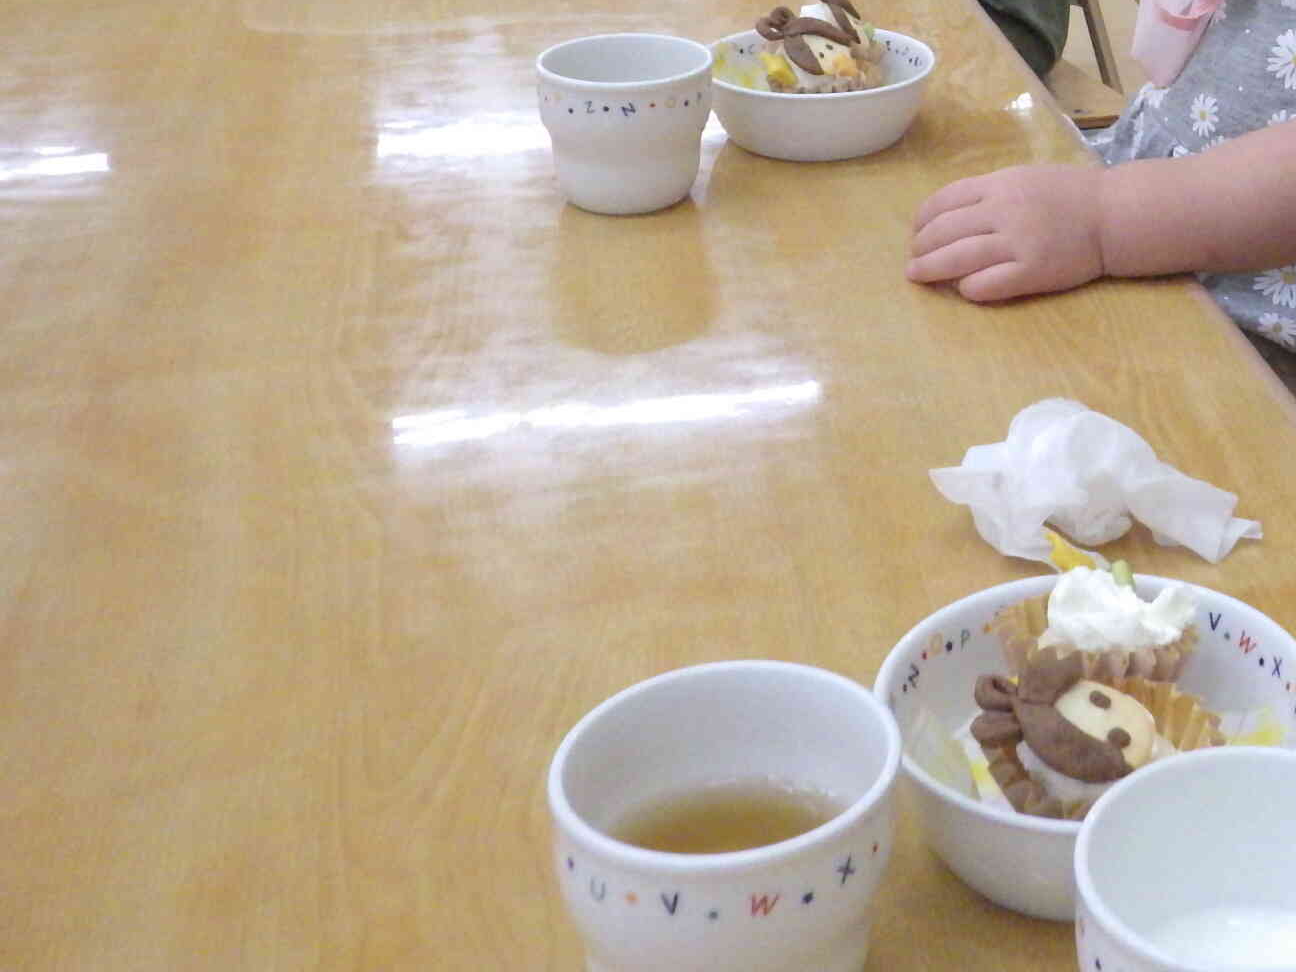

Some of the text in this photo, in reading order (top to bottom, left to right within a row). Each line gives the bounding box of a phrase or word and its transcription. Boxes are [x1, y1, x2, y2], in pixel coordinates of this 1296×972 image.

[1208, 611, 1222, 631] V
[1271, 655, 1283, 678] X
[588, 878, 606, 902] U
[659, 891, 680, 916] V
[749, 892, 781, 916] W
